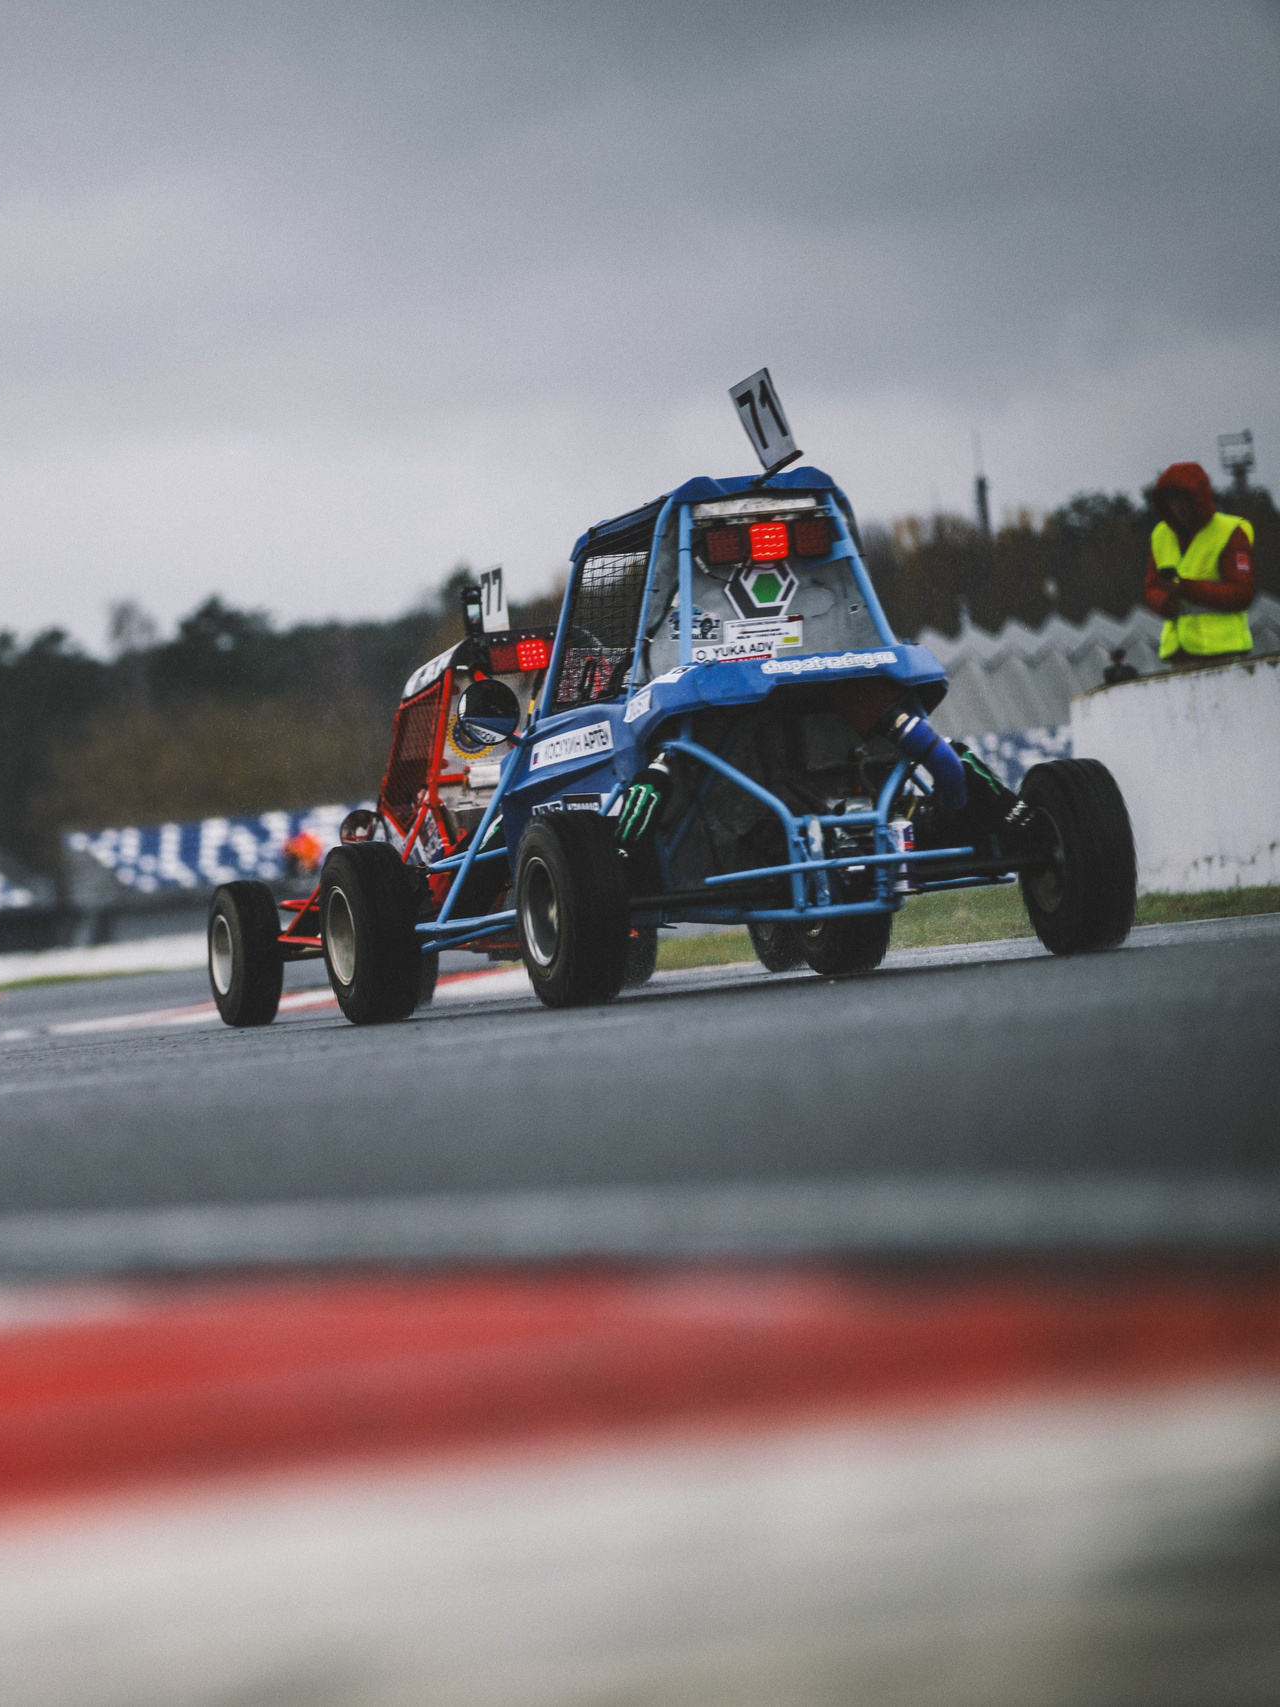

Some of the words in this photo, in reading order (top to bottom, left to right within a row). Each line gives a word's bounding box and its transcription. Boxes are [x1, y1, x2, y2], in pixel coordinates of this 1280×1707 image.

[736, 379, 788, 450] 71
[480, 568, 502, 615] 77
[713, 645, 747, 658] YUKA
[749, 641, 775, 653] ADV
[760, 651, 898, 675] shop.at-racing.ru
